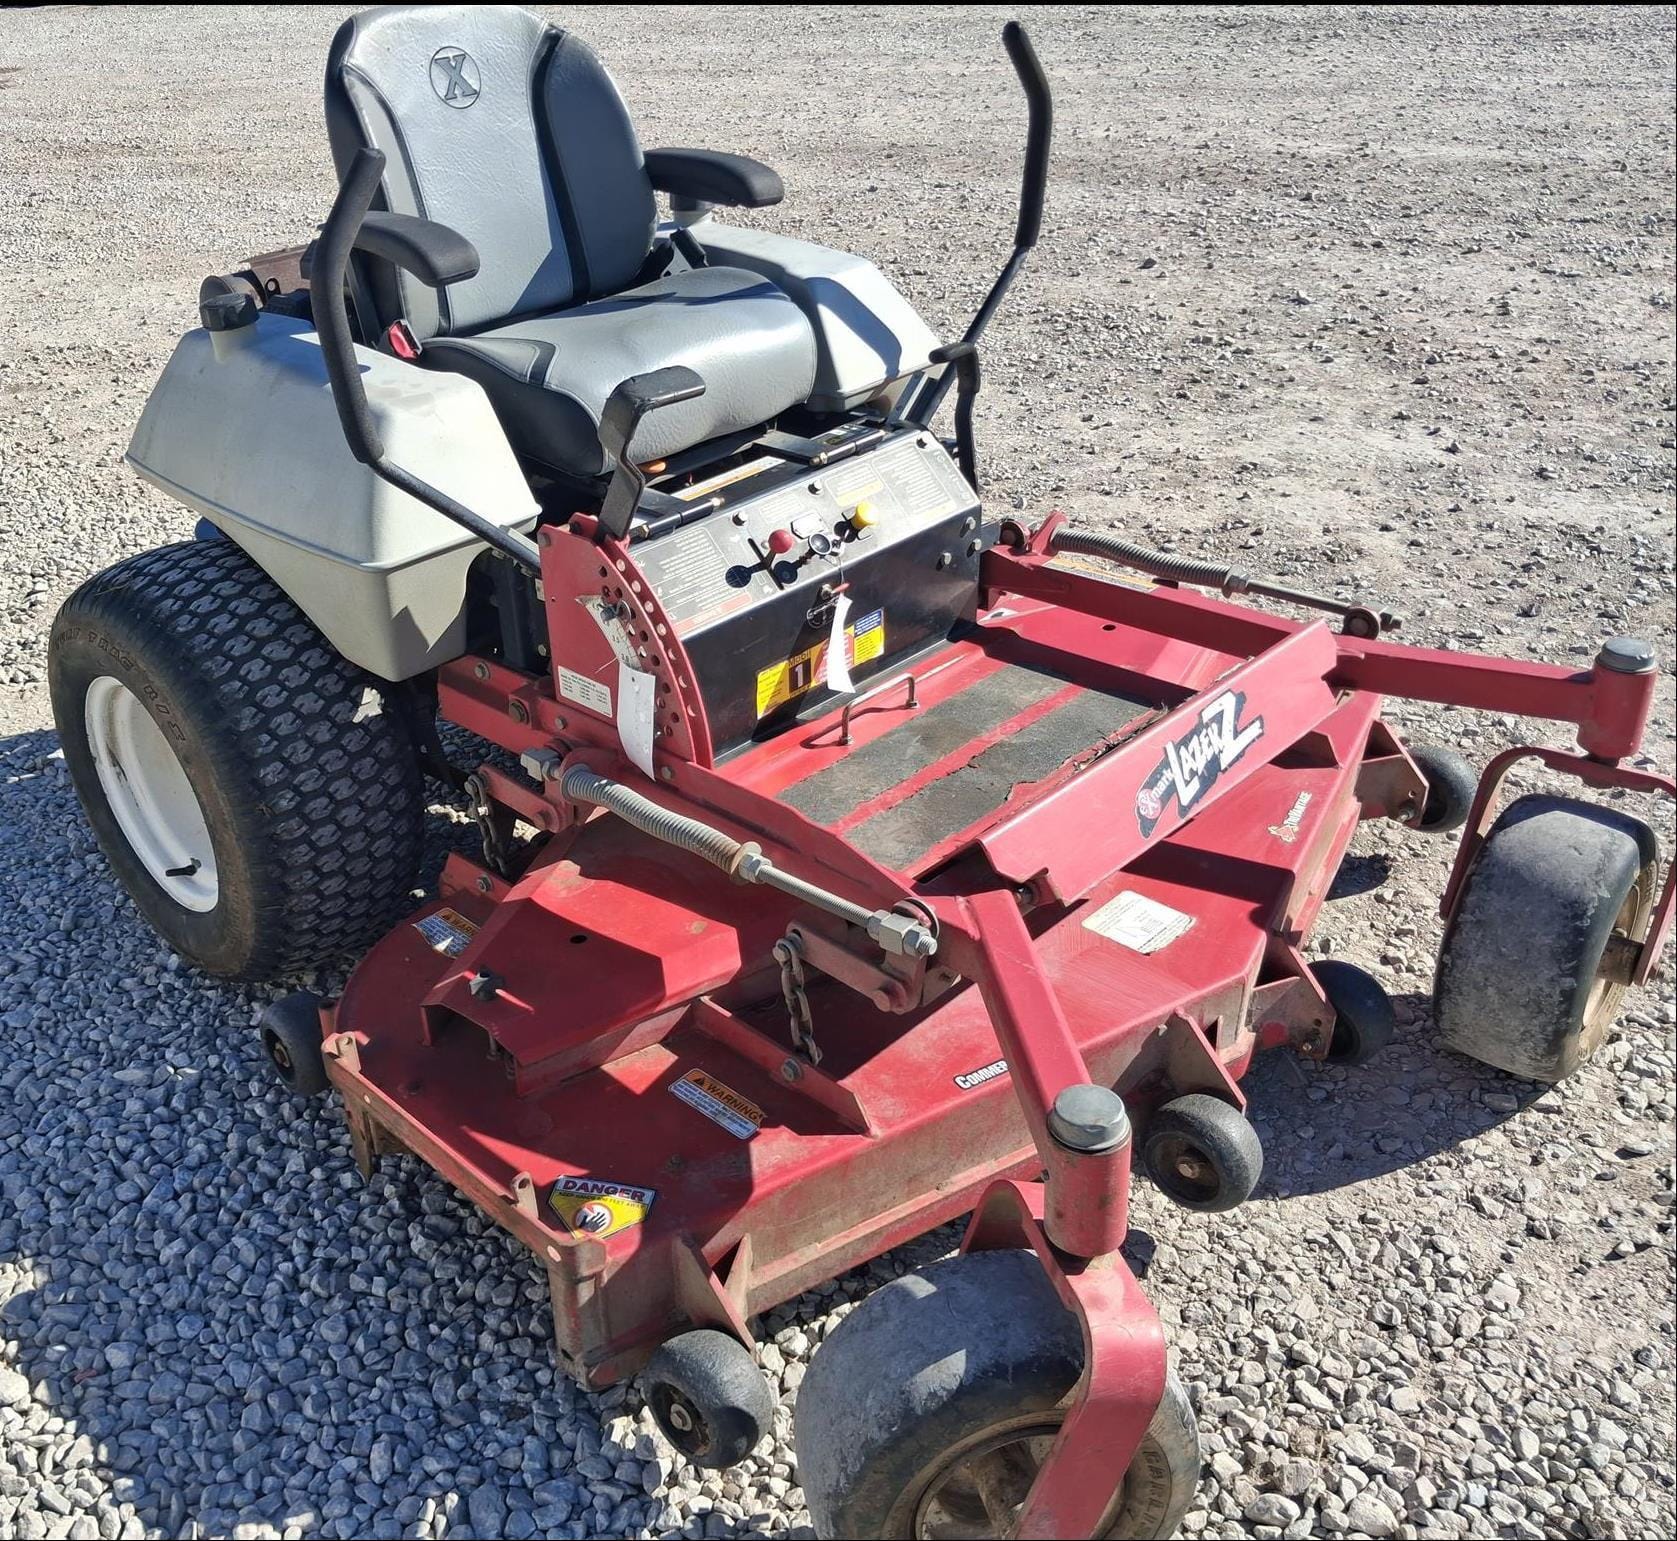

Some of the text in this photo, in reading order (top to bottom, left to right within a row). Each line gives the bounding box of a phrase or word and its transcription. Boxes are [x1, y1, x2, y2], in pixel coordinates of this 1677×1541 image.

[434, 53, 478, 100] X
[794, 663, 805, 689] 1
[563, 1179, 646, 1202] DANGER
